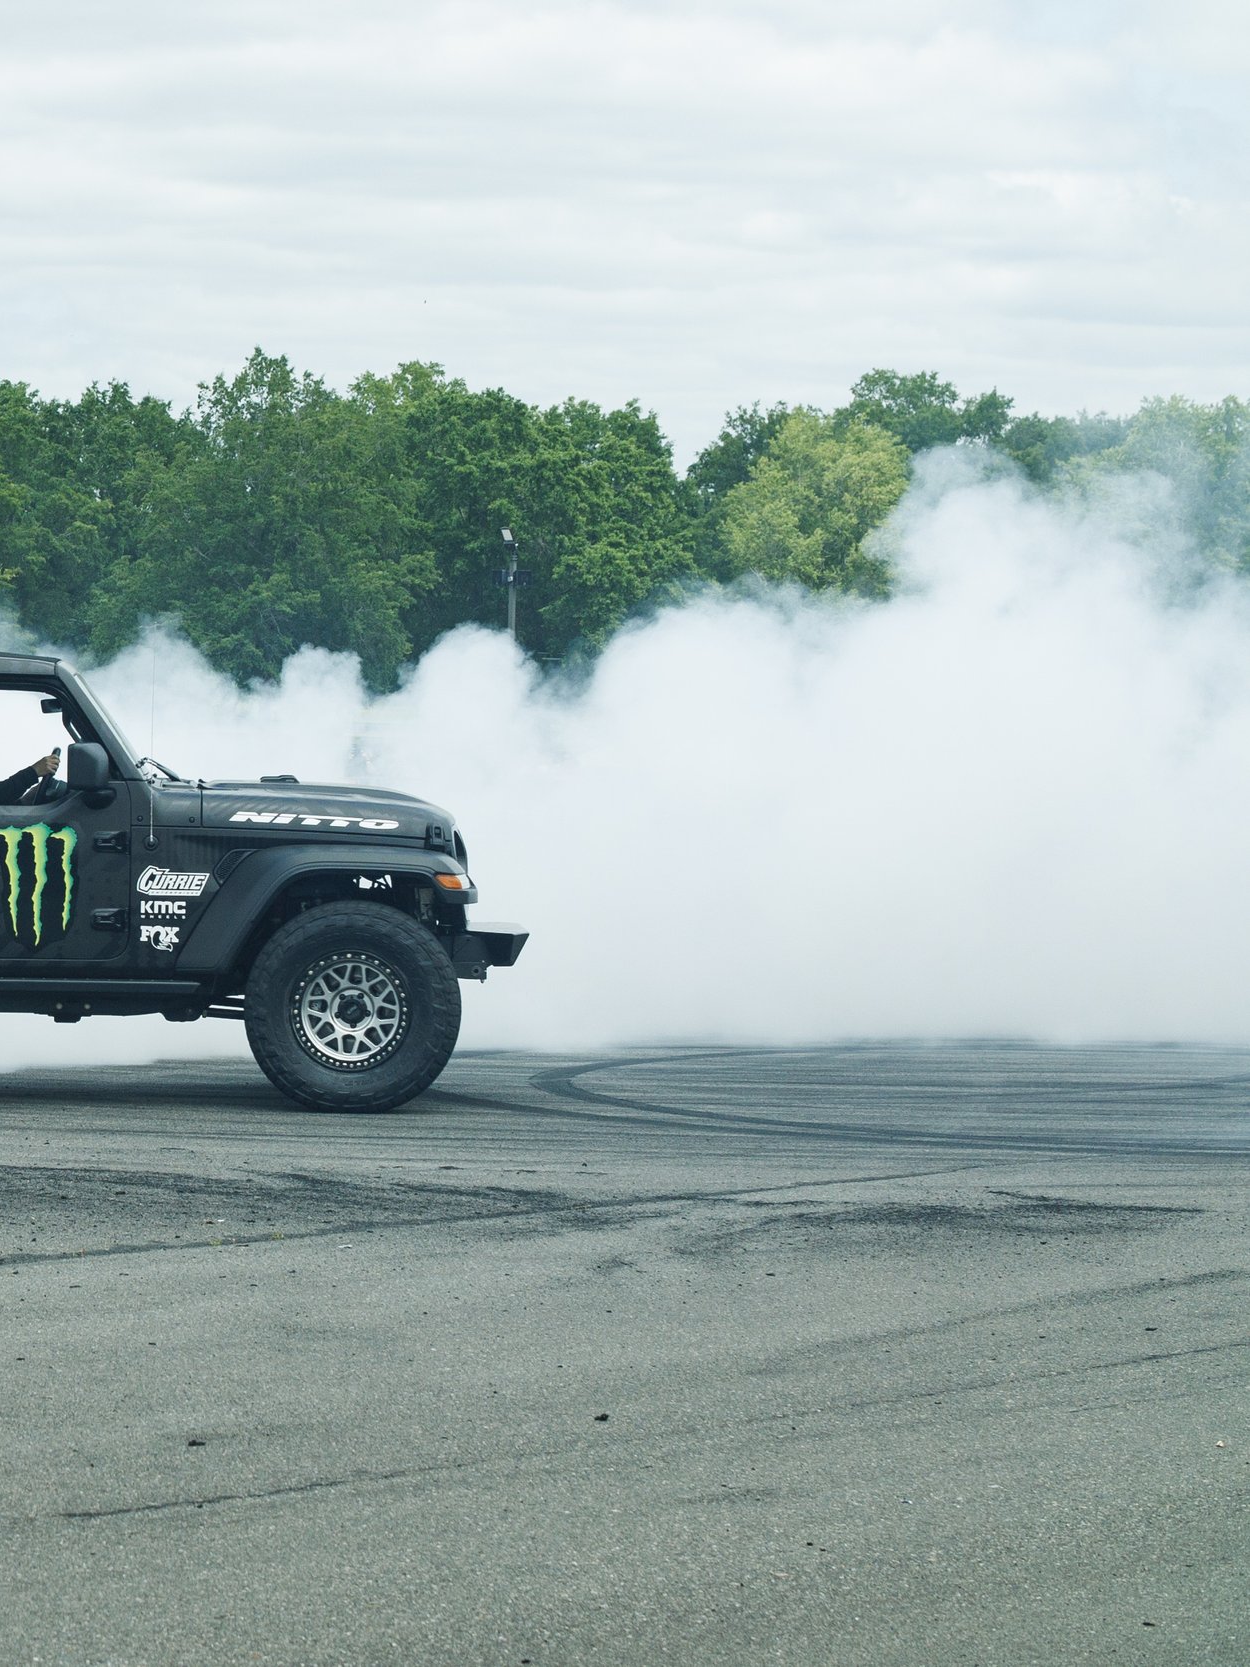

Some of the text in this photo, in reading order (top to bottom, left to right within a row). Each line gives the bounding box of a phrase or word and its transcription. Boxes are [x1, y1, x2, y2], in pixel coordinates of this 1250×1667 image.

[229, 811, 399, 830] NITTO
[139, 868, 206, 891] CURRIE
[139, 925, 180, 952] FOX
